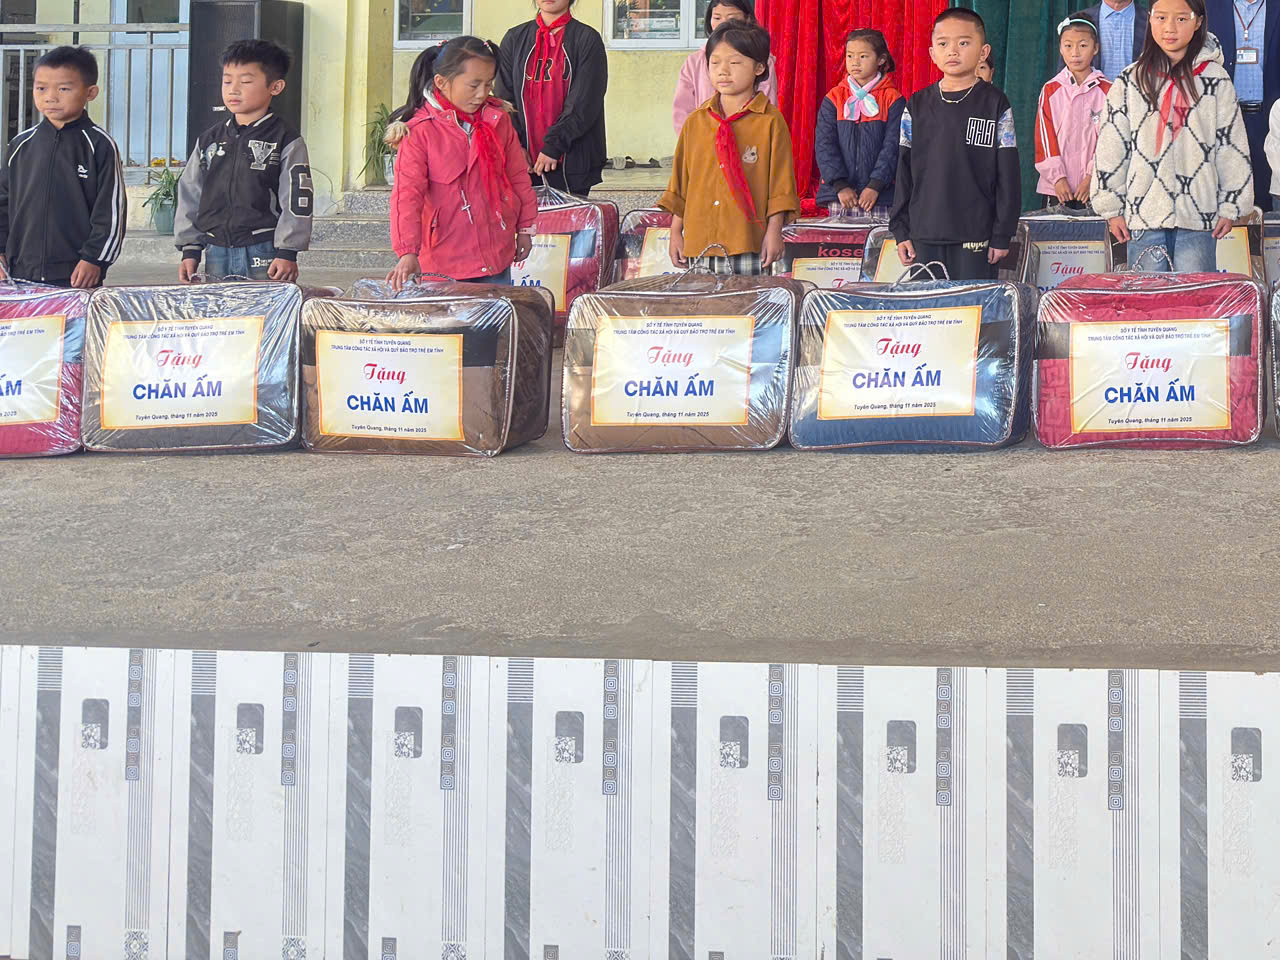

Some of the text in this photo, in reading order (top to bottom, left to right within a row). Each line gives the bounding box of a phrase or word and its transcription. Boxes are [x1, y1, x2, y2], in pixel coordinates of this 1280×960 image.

[248, 140, 277, 170] Y
[288, 163, 314, 218] 6
[1051, 262, 1084, 276] Tặng
[156, 350, 202, 368] Tặng
[648, 346, 693, 367] Tặng
[877, 338, 921, 358] Tặng
[1125, 352, 1171, 372] Tặng
[364, 364, 405, 384] Tặng
[624, 373, 714, 396] CHĂN ẤM
[853, 363, 941, 388] CHĂN ẤM
[133, 374, 222, 400] CHĂN ẤM
[1105, 378, 1194, 403] CHĂN ẤM
[347, 391, 428, 413] CHĂN ẤM
